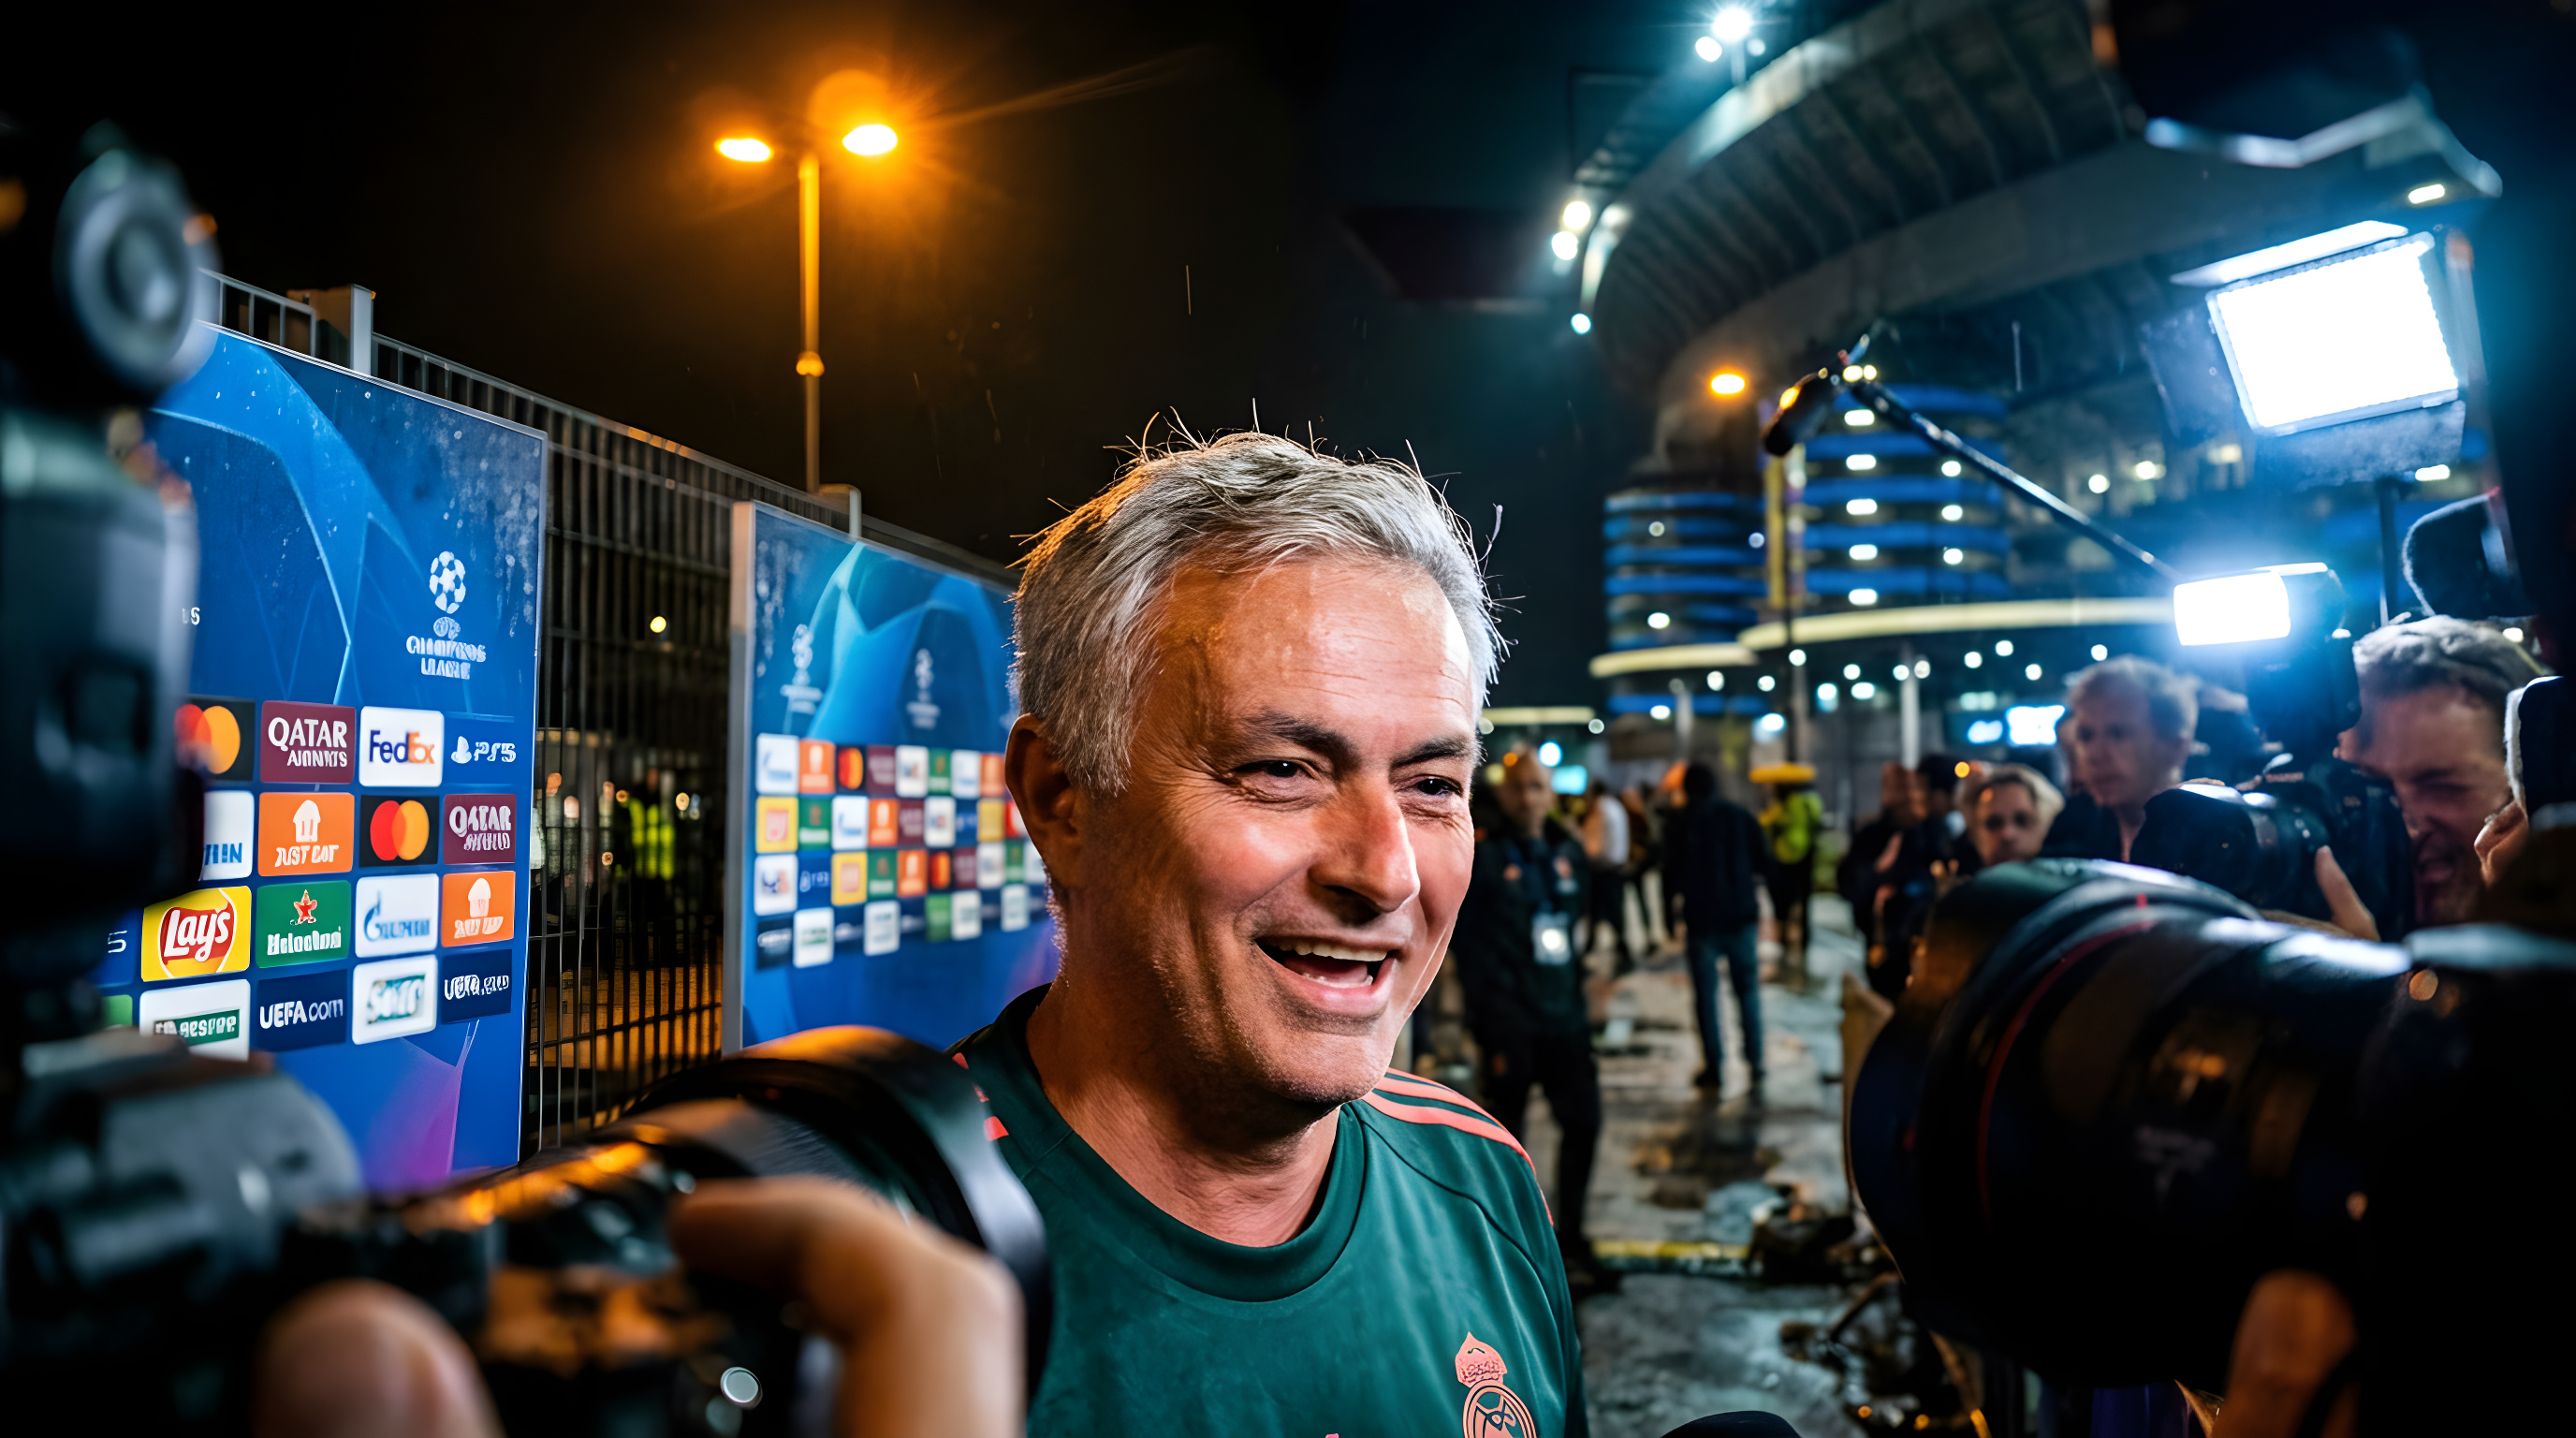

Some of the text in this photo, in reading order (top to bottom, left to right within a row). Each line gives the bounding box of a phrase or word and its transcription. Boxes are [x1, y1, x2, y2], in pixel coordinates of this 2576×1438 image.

[268, 717, 347, 751] QATAR
[370, 730, 435, 765] FedEx
[474, 741, 517, 763] PS5
[449, 805, 512, 837] QATAR
